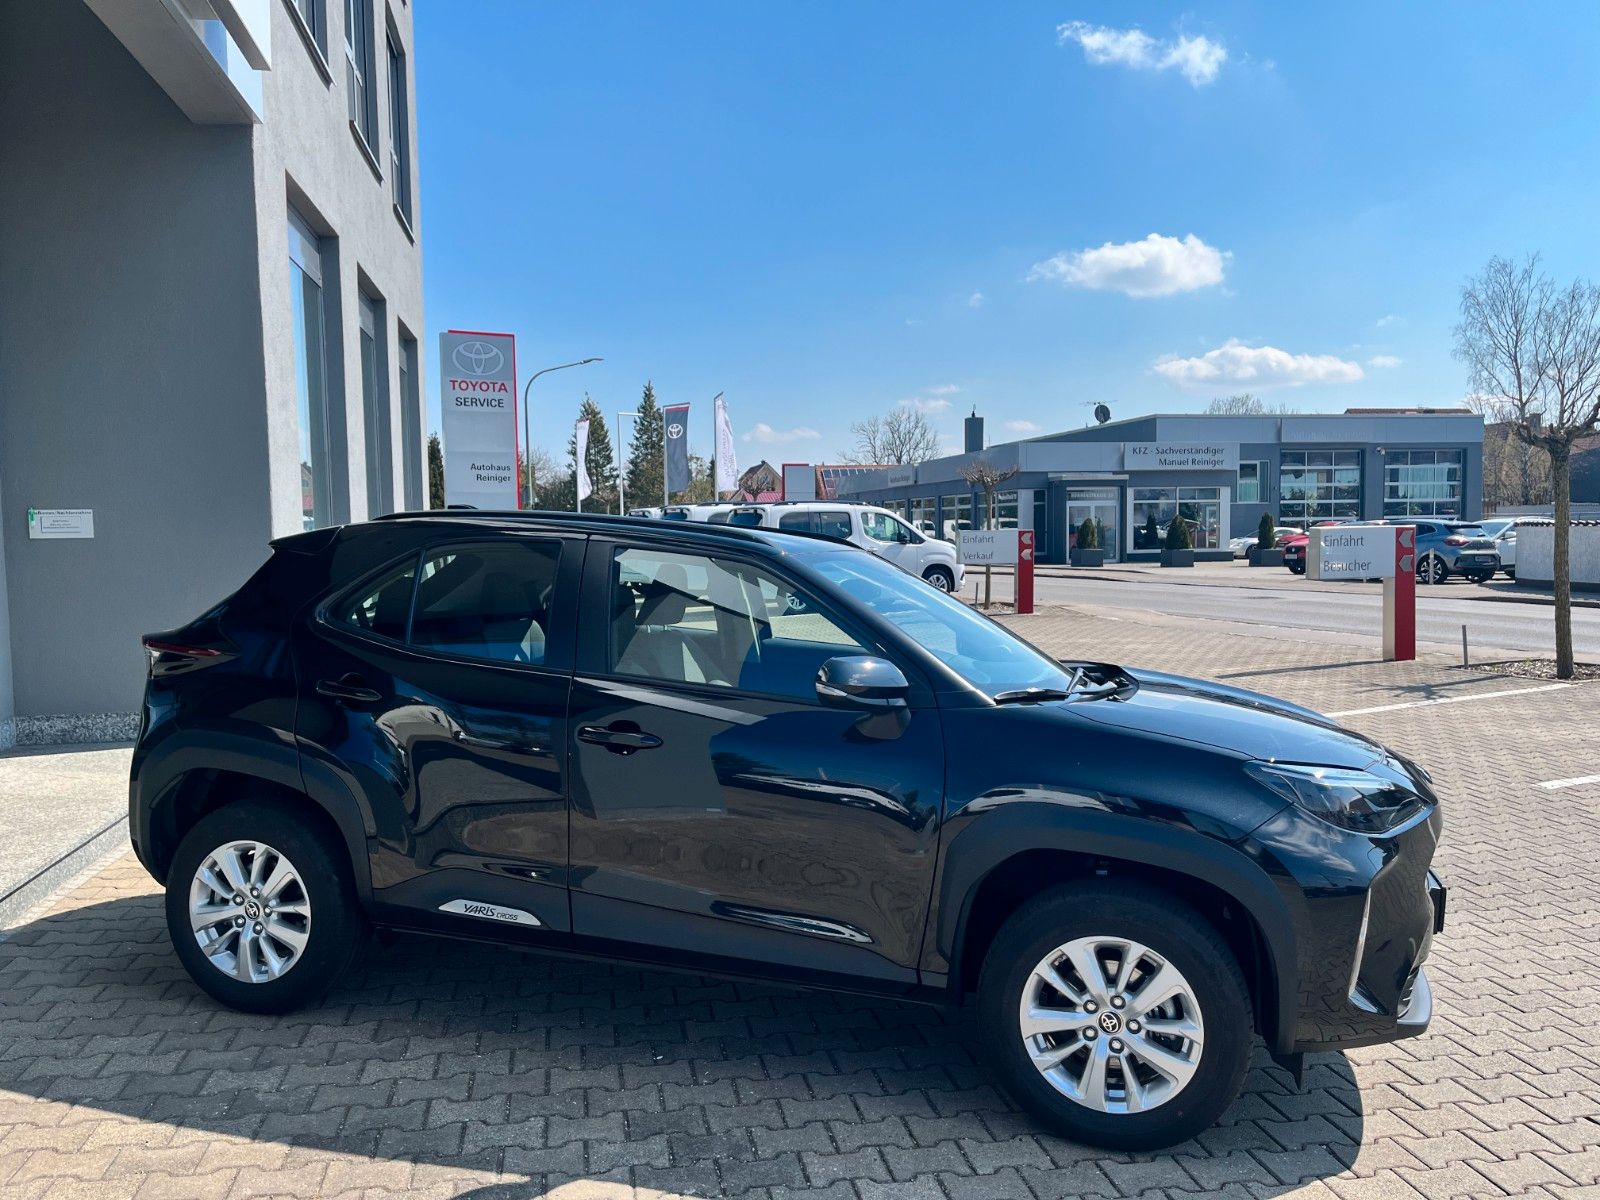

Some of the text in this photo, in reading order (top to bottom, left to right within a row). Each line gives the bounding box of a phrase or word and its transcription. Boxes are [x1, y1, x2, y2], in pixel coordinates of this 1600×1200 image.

[449, 380, 508, 393] TOYOTA
[455, 397, 504, 408] SERVICE
[1132, 446, 1149, 455] KFZ
[470, 463, 510, 471] Autohaus
[1158, 457, 1225, 467] Manuel Reiniger
[476, 473, 510, 483] Reiniger
[963, 535, 995, 544] Einfahrt
[1323, 535, 1365, 547] Einfahrt
[963, 552, 994, 561] Verkauf
[1323, 560, 1372, 572] Besucher
[464, 903, 519, 921] YARIS CROSS
